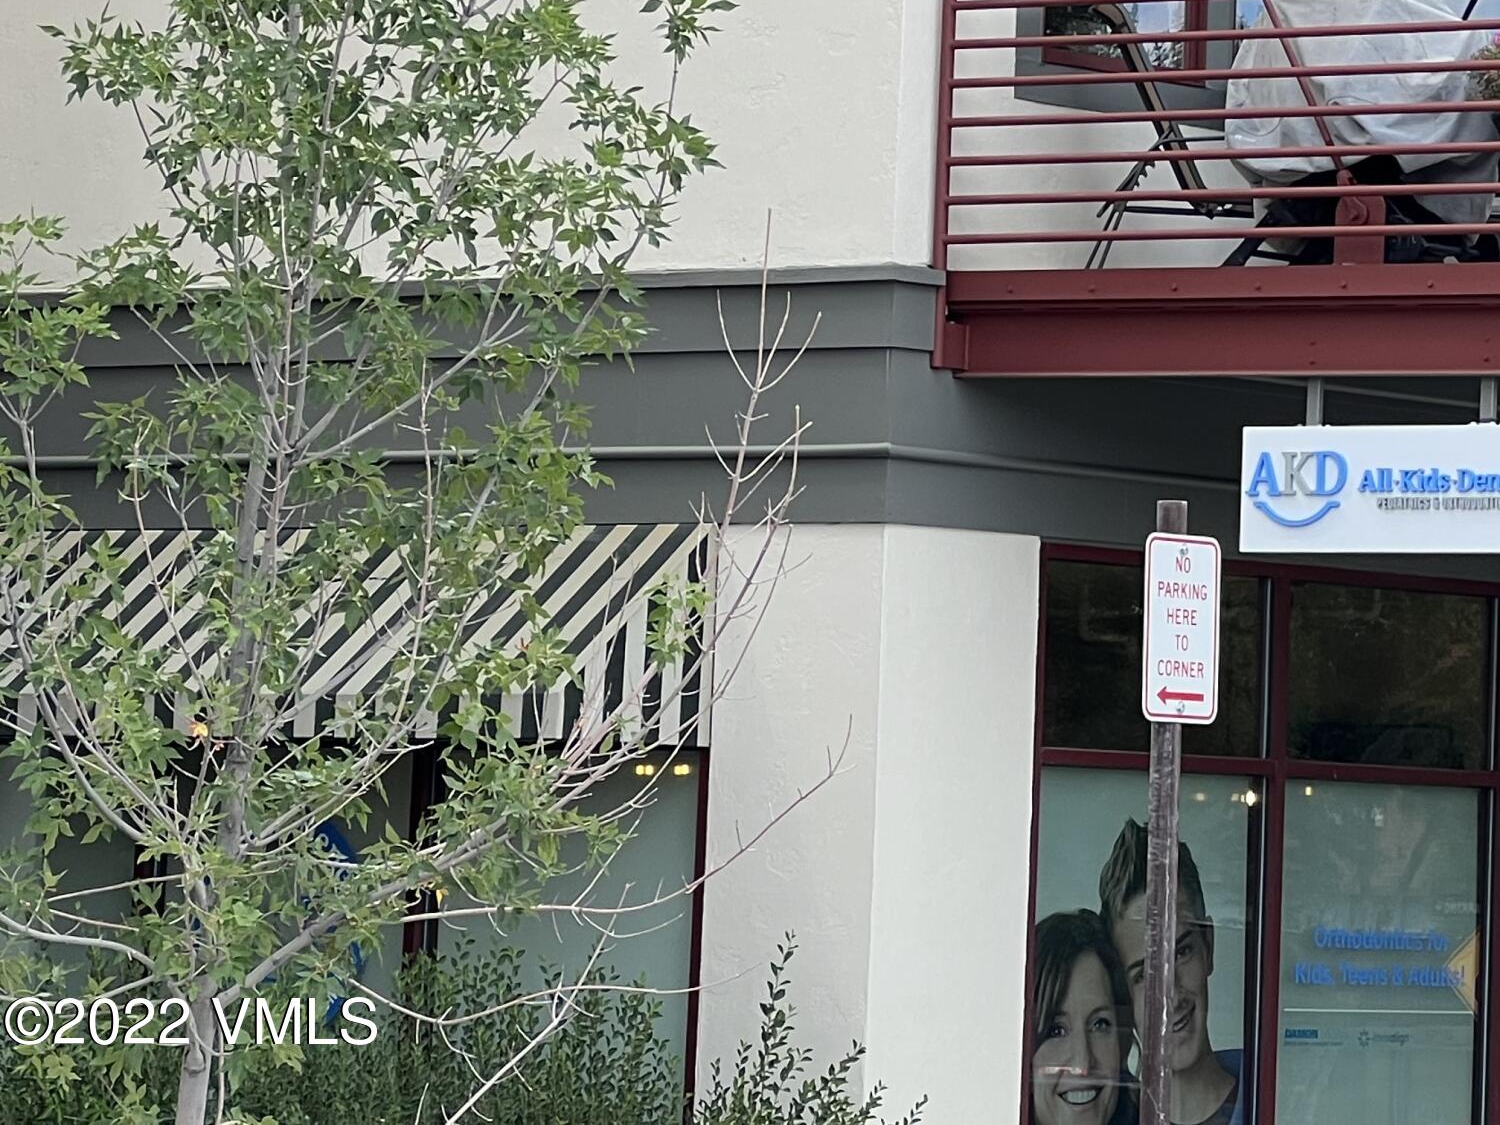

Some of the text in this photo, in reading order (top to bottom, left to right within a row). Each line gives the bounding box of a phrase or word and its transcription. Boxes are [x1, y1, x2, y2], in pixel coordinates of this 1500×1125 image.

[1245, 450, 1348, 497] AKD
[1175, 557, 1191, 574] NO
[1157, 581, 1208, 601] PARKING
[1167, 608, 1198, 626] HERE
[1175, 634, 1189, 651] TO
[1157, 660, 1204, 679] CORNER
